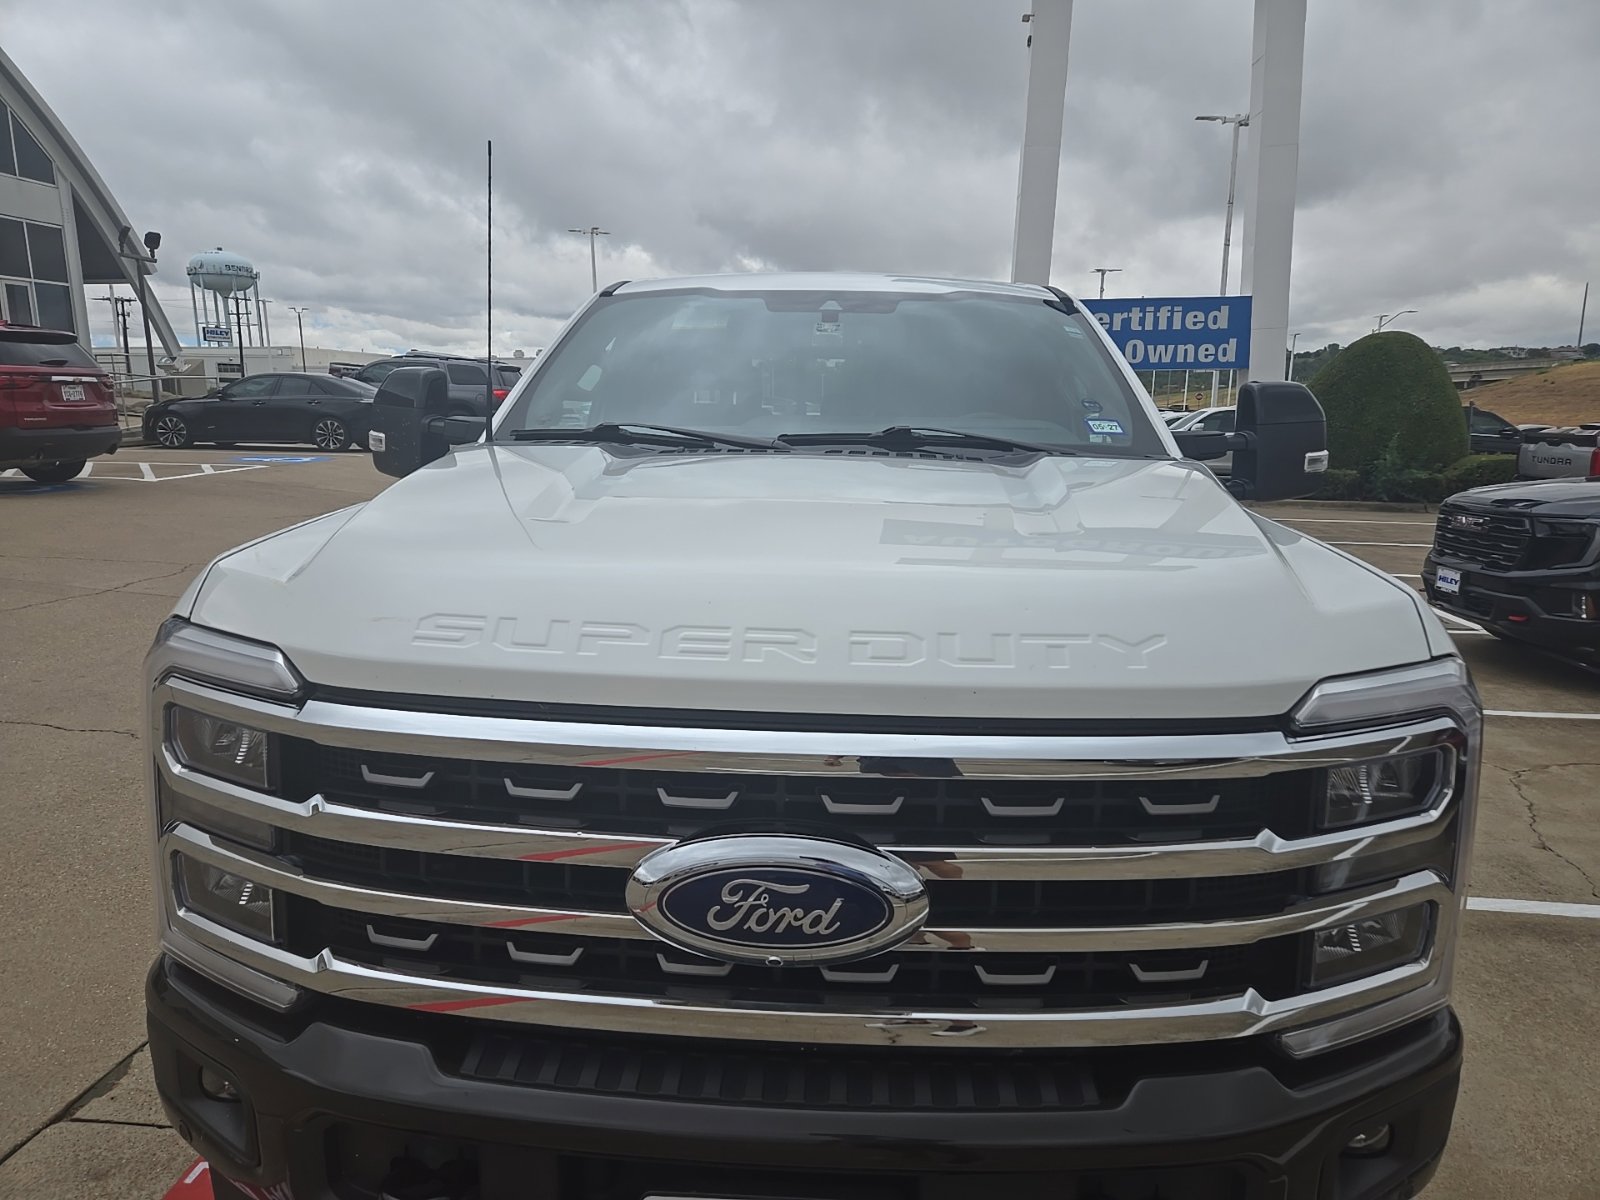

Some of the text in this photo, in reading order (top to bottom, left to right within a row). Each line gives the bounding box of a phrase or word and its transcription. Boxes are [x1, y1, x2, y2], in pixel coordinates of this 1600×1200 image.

[1532, 456, 1571, 465] TUNDRA
[1438, 575, 1459, 585] HILEY
[412, 612, 1167, 669] SUPER DUTY
[707, 878, 844, 935] Ford
